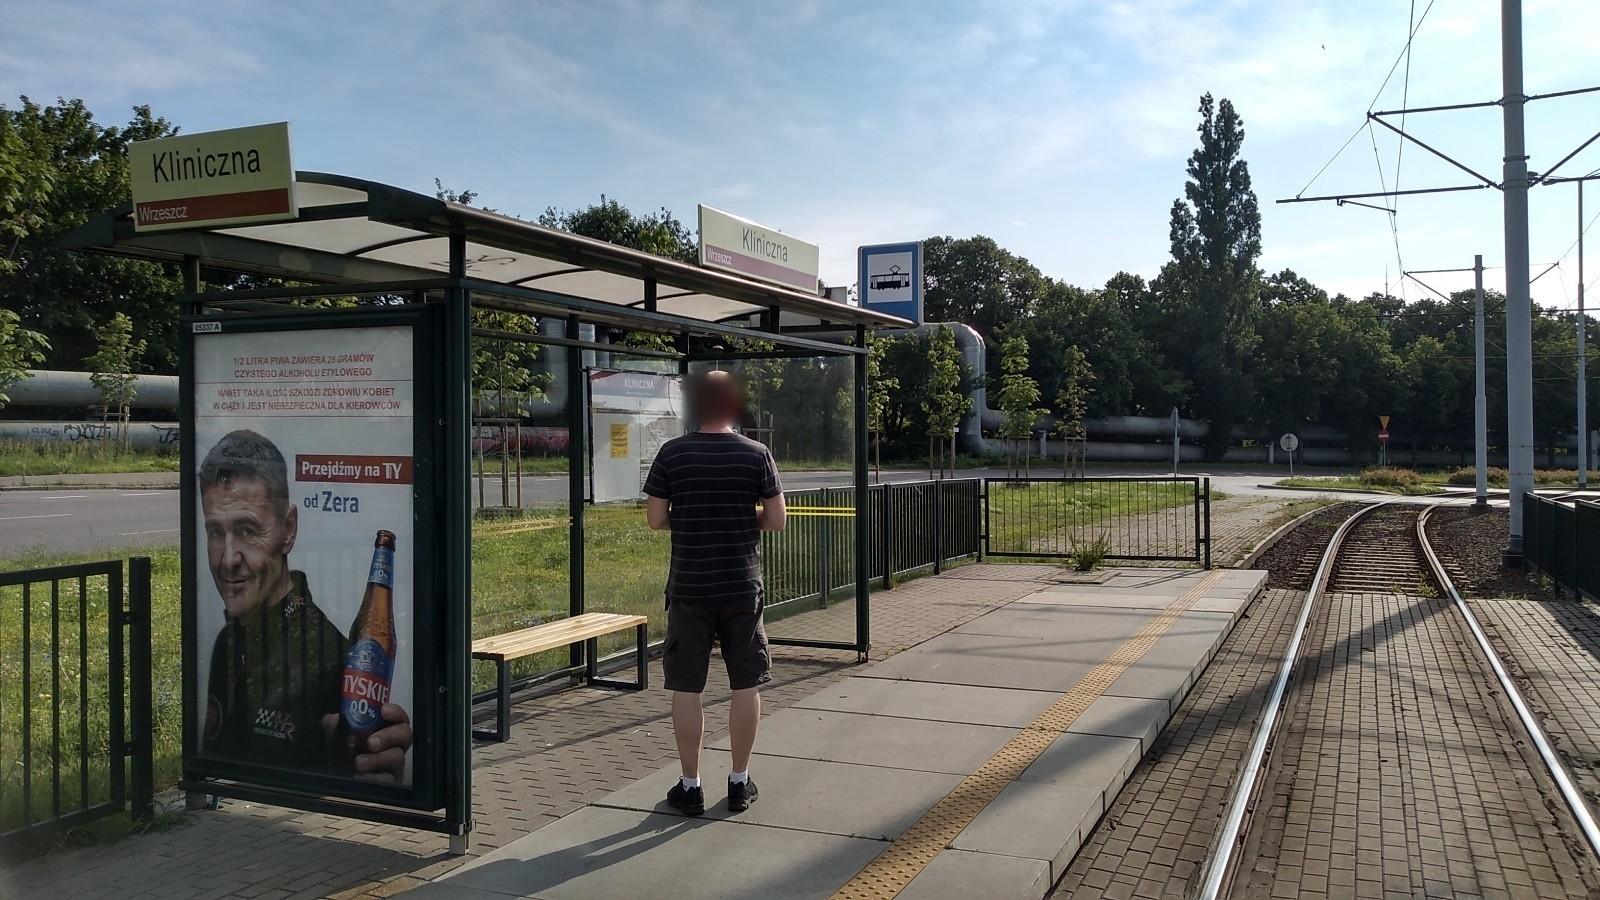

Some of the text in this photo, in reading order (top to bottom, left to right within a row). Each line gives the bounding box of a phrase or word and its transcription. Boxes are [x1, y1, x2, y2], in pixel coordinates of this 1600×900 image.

[153, 147, 261, 183] Kliniczna
[139, 206, 188, 222] Wrzeszcz
[742, 227, 788, 262] Kliniczna
[706, 247, 733, 265] Wrzeszcz
[234, 357, 245, 366] 1/2
[246, 357, 269, 366] LITRA
[271, 356, 290, 365] PIWA
[291, 355, 326, 365] ZAWIERA
[327, 355, 336, 364] 25
[234, 367, 372, 378] CZYSTEGO ALKOHOLU ETYLOWEGO
[217, 388, 241, 397] NAWET
[244, 388, 265, 397] TAKA
[288, 388, 321, 397] SZKODZI
[322, 387, 361, 397] ZDROWIU
[363, 387, 395, 397] KOBIET
[213, 402, 219, 410] W
[246, 401, 267, 410] JEST
[268, 401, 326, 410] NIEBEZPIECZNA
[328, 401, 344, 410] DLA
[346, 399, 400, 410] KIEROWCÓW
[302, 460, 402, 480] Przejdźmy na TY
[304, 490, 359, 513] od Zera
